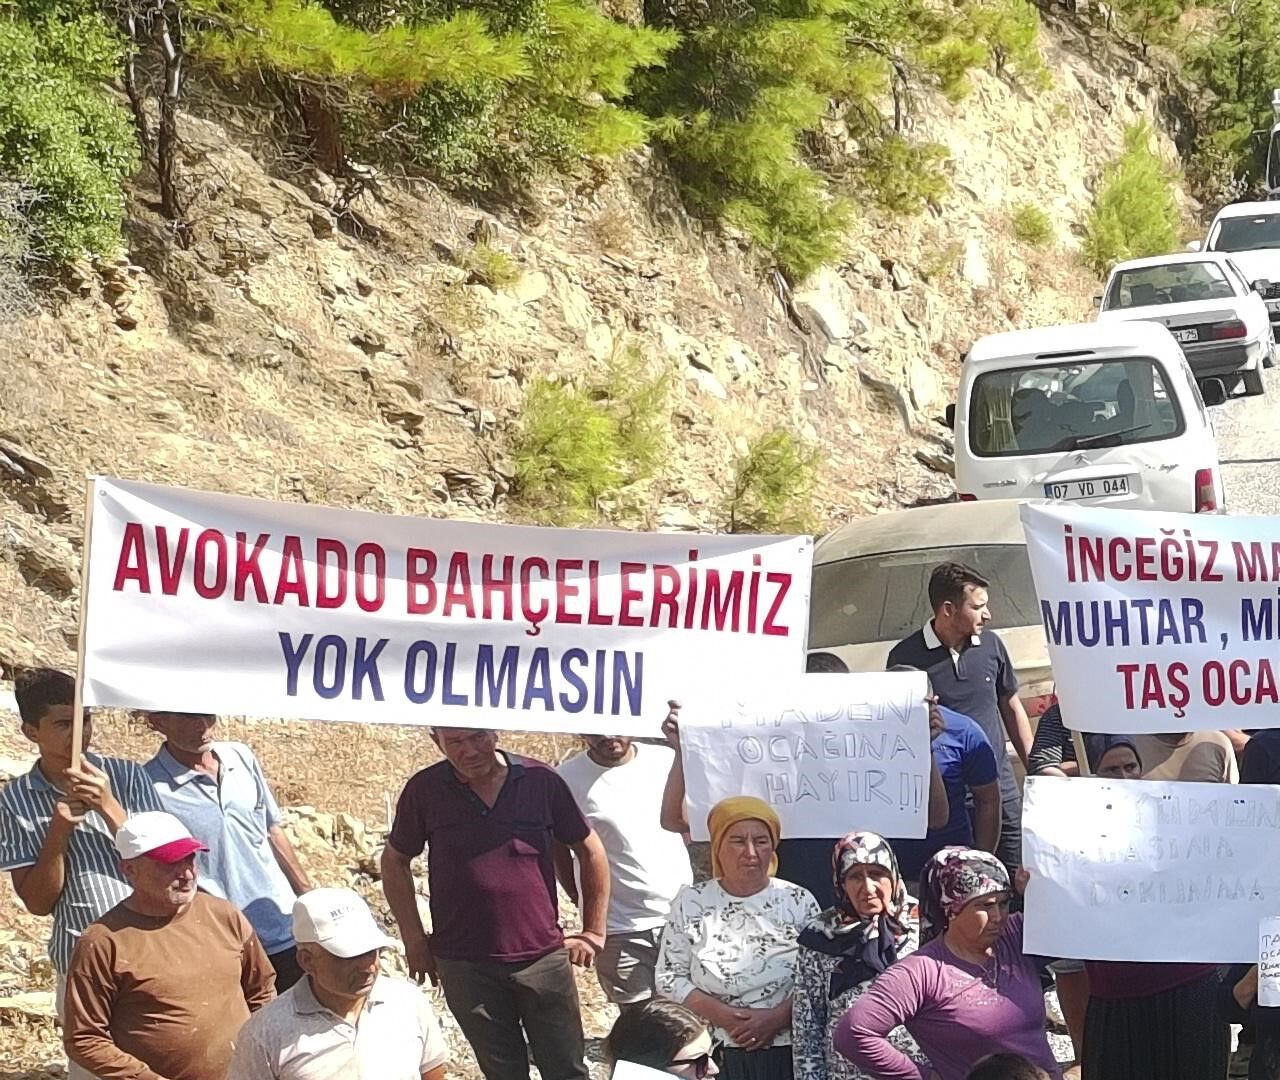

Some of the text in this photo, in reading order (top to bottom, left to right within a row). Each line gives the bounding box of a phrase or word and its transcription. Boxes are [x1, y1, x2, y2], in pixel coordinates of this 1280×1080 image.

[1053, 479, 1127, 498] 07 VD 044
[113, 521, 793, 637] AVOKADO BAHÇELERİMİZ
[1064, 524, 1224, 583] İNCEĞİZ
[279, 631, 645, 717] YOK OLMASIN
[1116, 661, 1191, 719] TAŞ
